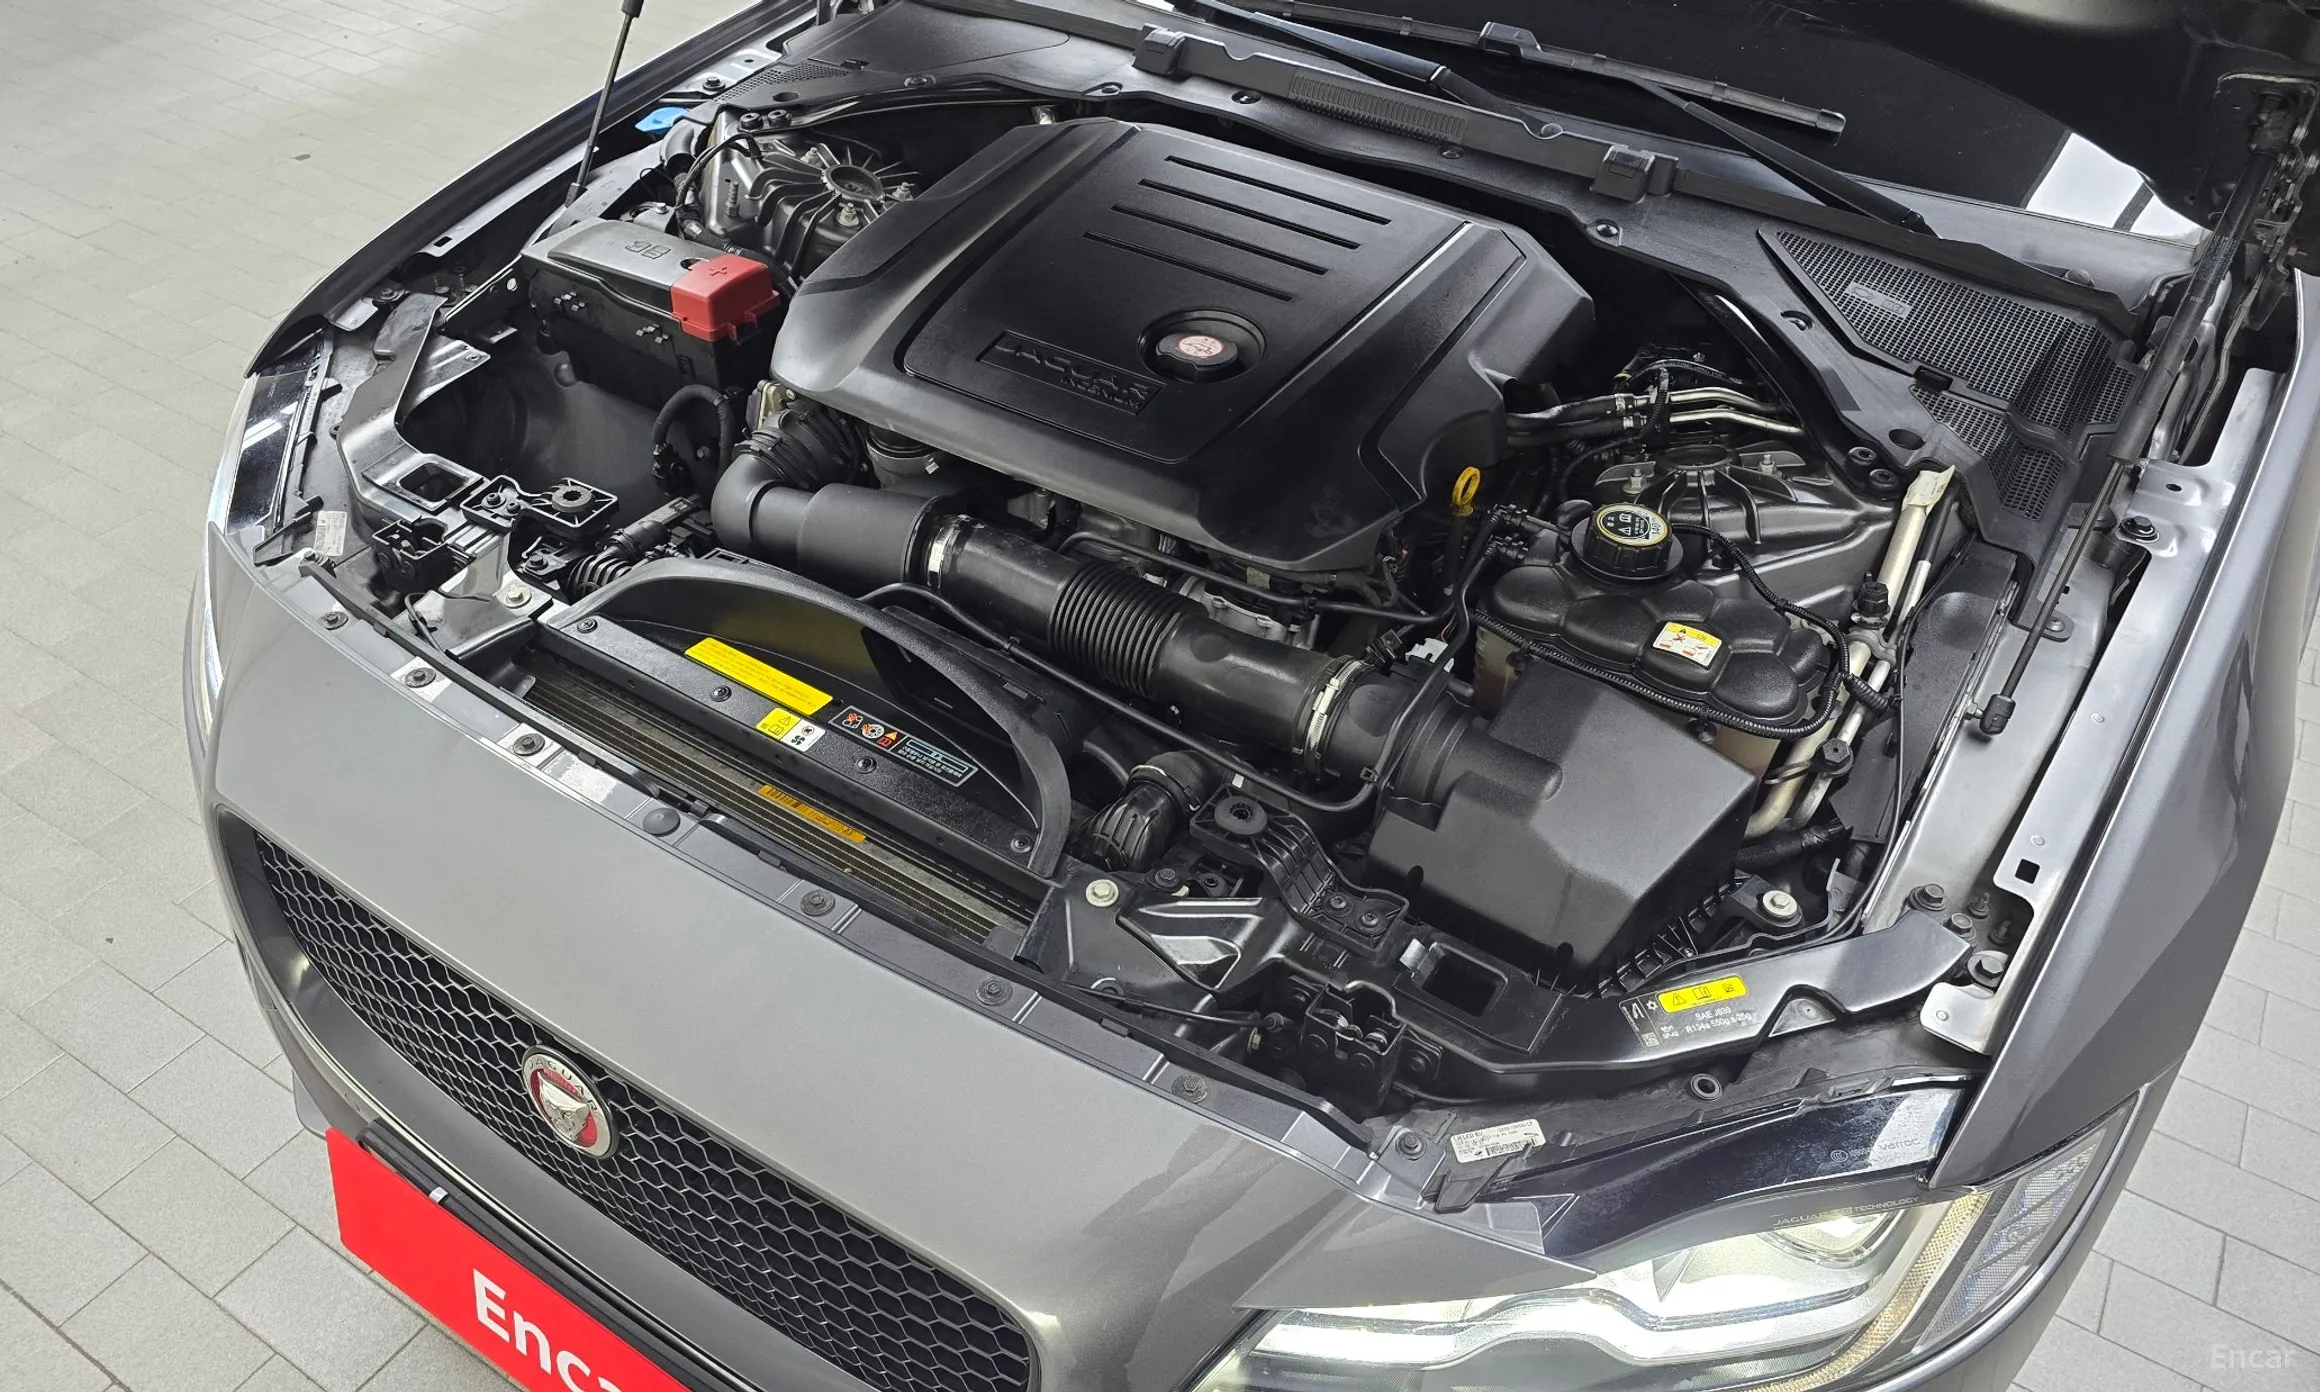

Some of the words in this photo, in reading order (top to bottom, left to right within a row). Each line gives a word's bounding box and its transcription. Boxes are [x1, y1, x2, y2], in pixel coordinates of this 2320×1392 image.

[994, 343, 1151, 400] JAGUAR
[1685, 1021, 1711, 1034] R134a
[527, 1058, 599, 1112] JAGUAR
[1853, 1195, 1920, 1213] TECHNOLOGY
[473, 1267, 626, 1392] Enc
